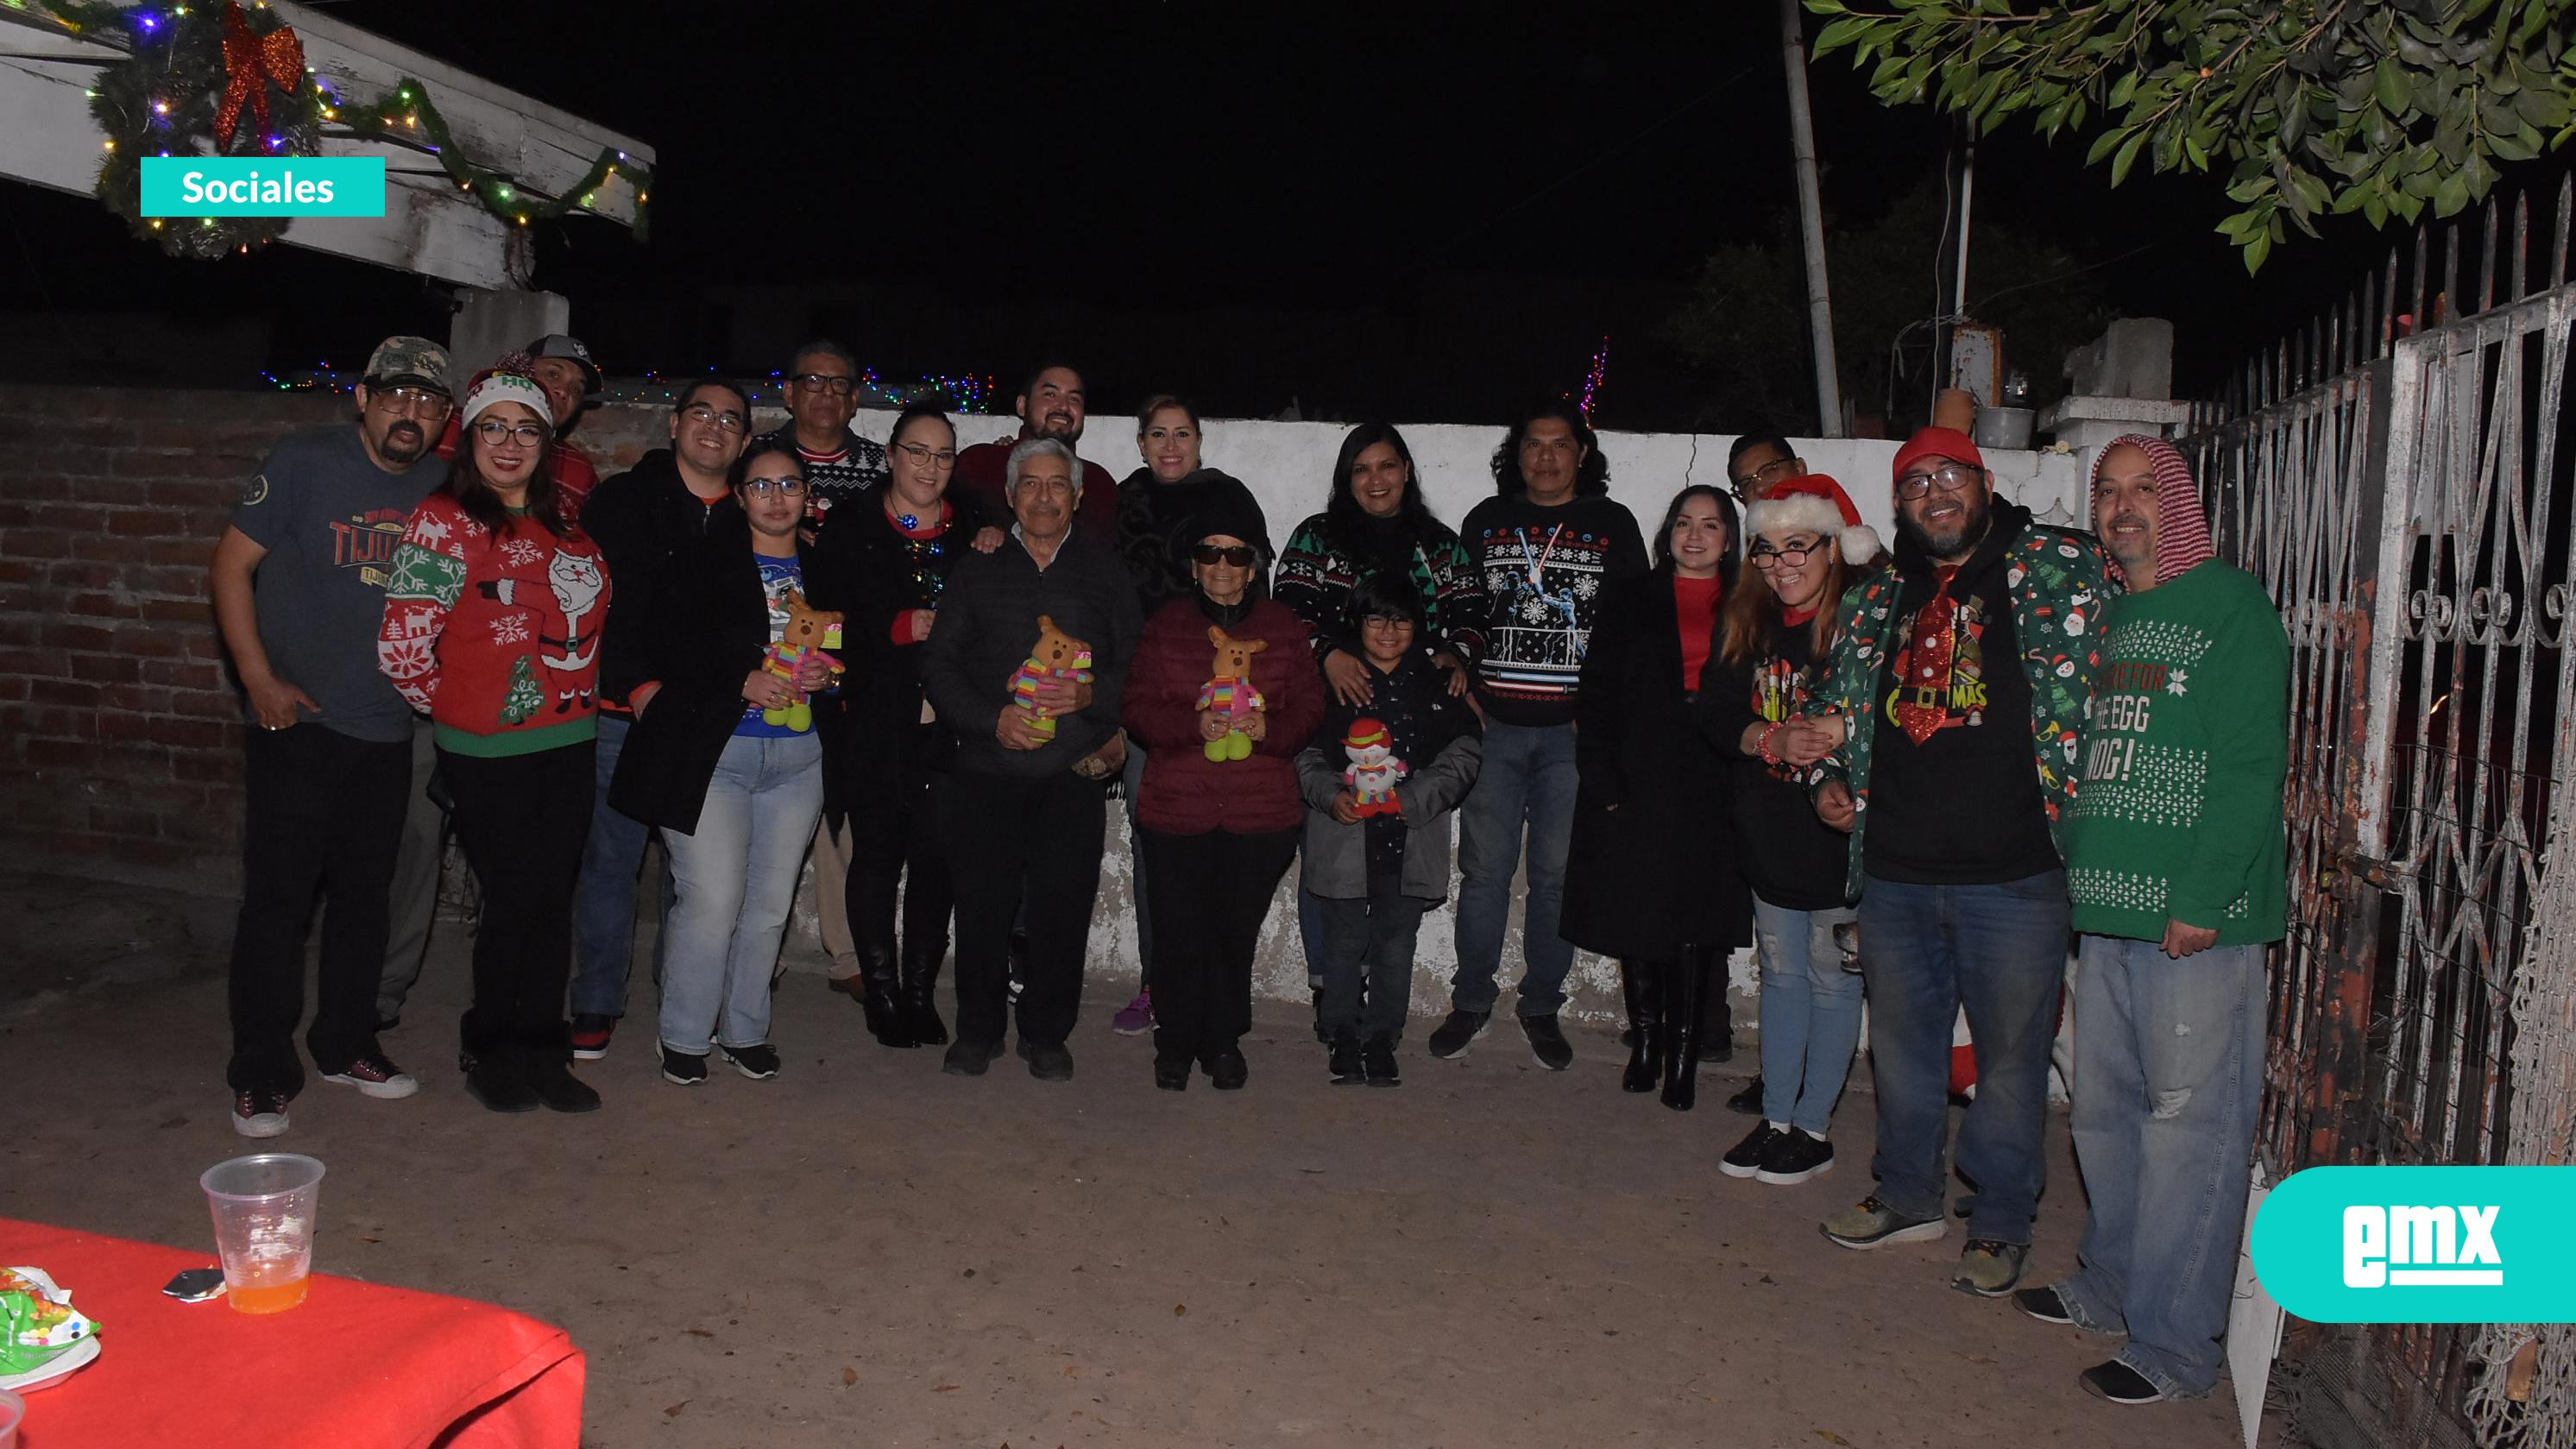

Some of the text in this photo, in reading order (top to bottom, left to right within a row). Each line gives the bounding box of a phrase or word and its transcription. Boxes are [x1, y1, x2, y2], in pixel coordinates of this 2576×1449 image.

[330, 520, 394, 566] TIJU
[2111, 695, 2151, 733] EGG
[2084, 738, 2136, 781] NOG!
